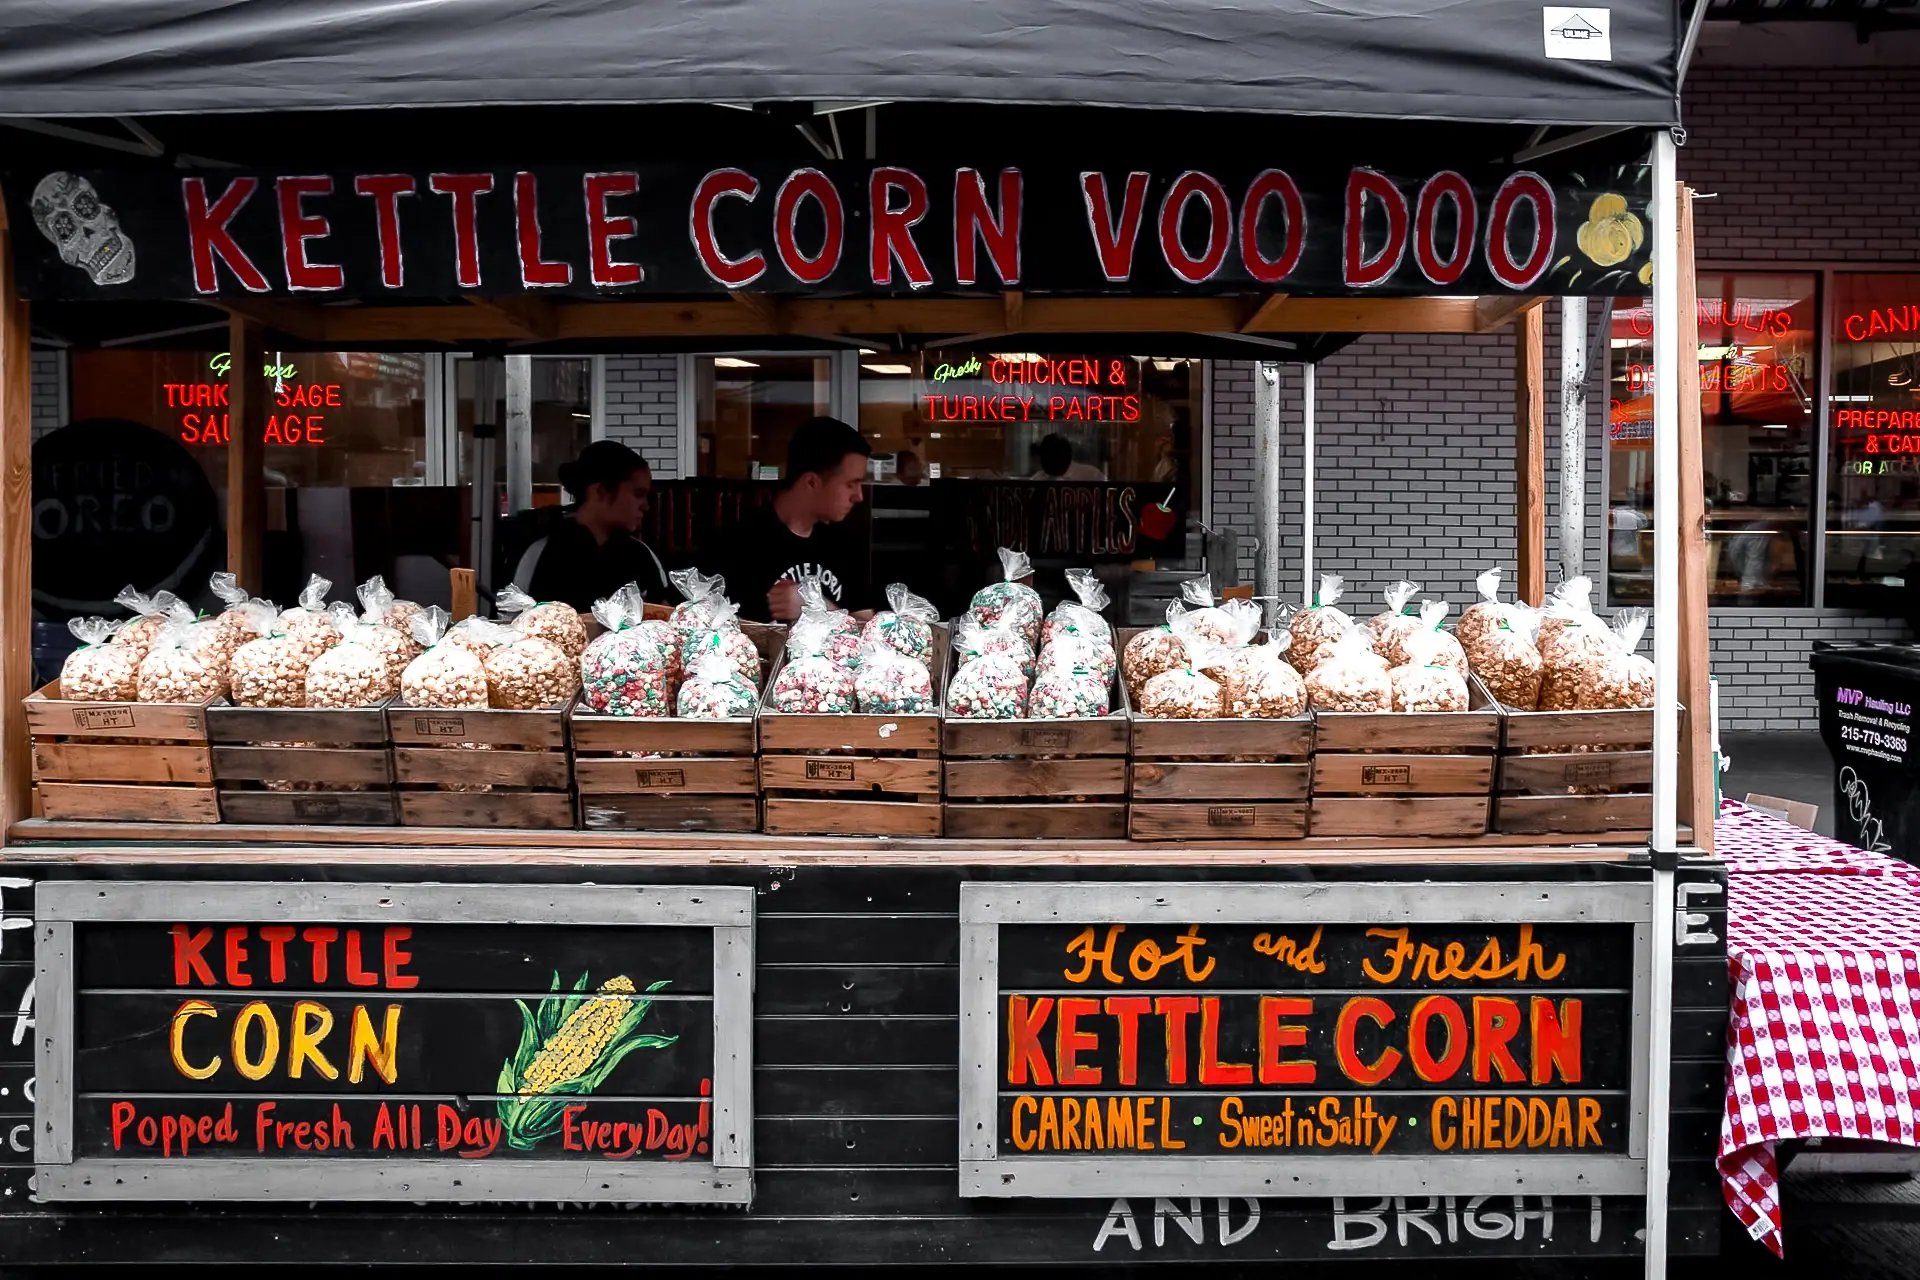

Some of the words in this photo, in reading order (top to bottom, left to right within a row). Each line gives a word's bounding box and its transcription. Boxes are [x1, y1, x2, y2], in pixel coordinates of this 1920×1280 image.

[182, 172, 645, 294] KETTLE
[689, 166, 1024, 290] CORN
[1080, 168, 1307, 284] VOO
[1343, 167, 1558, 291] DOO
[1631, 299, 1792, 338] CNULI'S
[934, 355, 982, 384] Fresh
[990, 359, 1100, 386] CHICKEN
[1108, 359, 1126, 386] &
[1699, 364, 1788, 391] MEATS
[163, 383, 231, 408] TURK
[922, 394, 1035, 422] TURKEY
[1049, 394, 1141, 422] PARTS
[181, 413, 326, 444] SAAGE
[33, 492, 177, 540] OREO
[1039, 486, 1138, 555] APPLES
[1837, 686, 1863, 706] MVP
[1865, 696, 1894, 715] Hauling
[1895, 701, 1911, 716] LLC
[1838, 709, 1854, 720] Trash
[1854, 712, 1879, 725] Removal
[1884, 719, 1910, 734] Recycling
[1841, 725, 1907, 752] 215-779-3363
[172, 925, 420, 990] KETTLE
[1063, 925, 1217, 985] Hot
[1252, 926, 1326, 974] and
[1361, 924, 1567, 985] Fresh
[170, 999, 401, 1085] CORN
[1007, 994, 1317, 1087] KETTLE
[1335, 994, 1583, 1087] CORN
[112, 1101, 239, 1158] Popped
[256, 1102, 353, 1151] Fresh
[373, 1103, 421, 1150] All
[437, 1105, 502, 1159] Day
[1012, 1096, 1187, 1151] CARAMEL
[1430, 1096, 1603, 1151] CHEDDAR
[1093, 1196, 1262, 1252] AND
